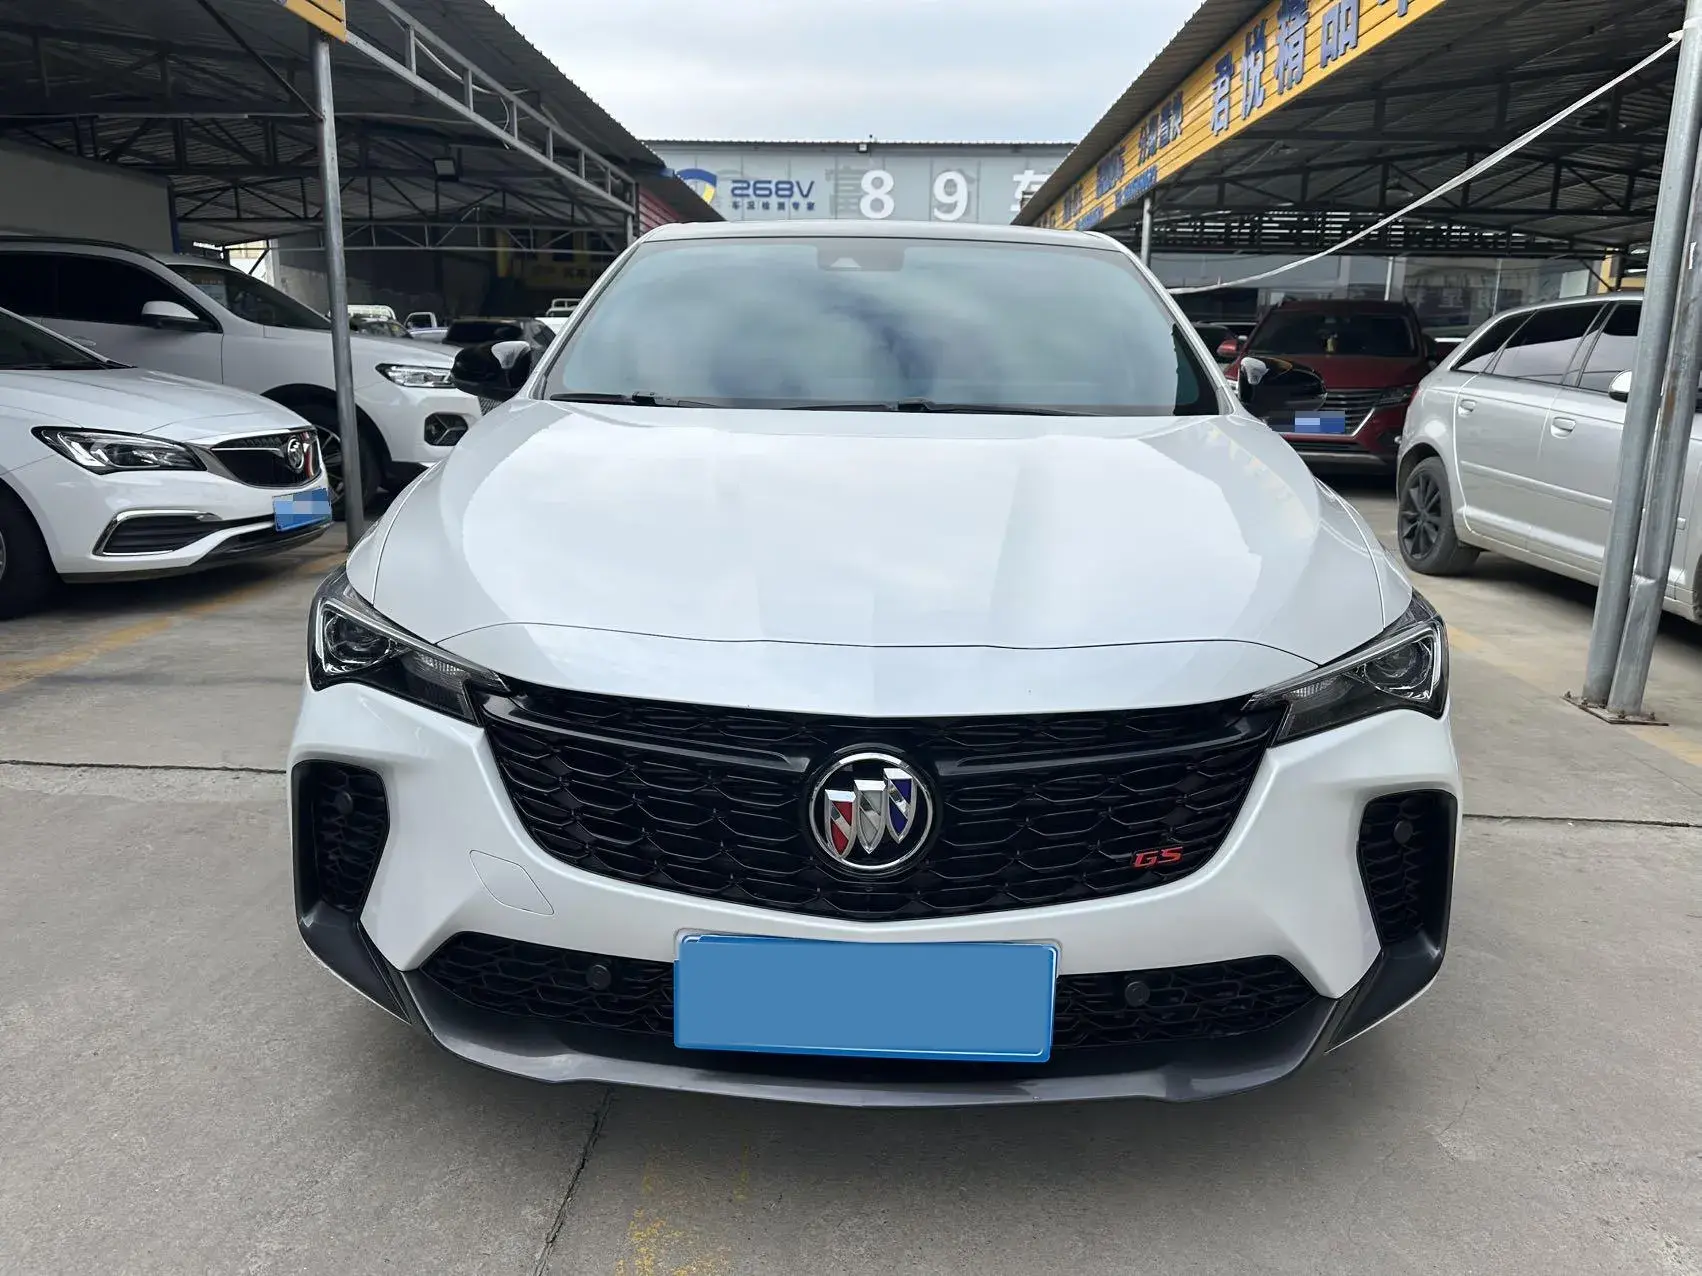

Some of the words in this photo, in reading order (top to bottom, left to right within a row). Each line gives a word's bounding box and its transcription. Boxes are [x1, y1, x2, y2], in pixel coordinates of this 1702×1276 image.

[1210, 0, 1408, 136] 君悦精品
[731, 180, 815, 198] 268V
[1133, 846, 1183, 868] GS
